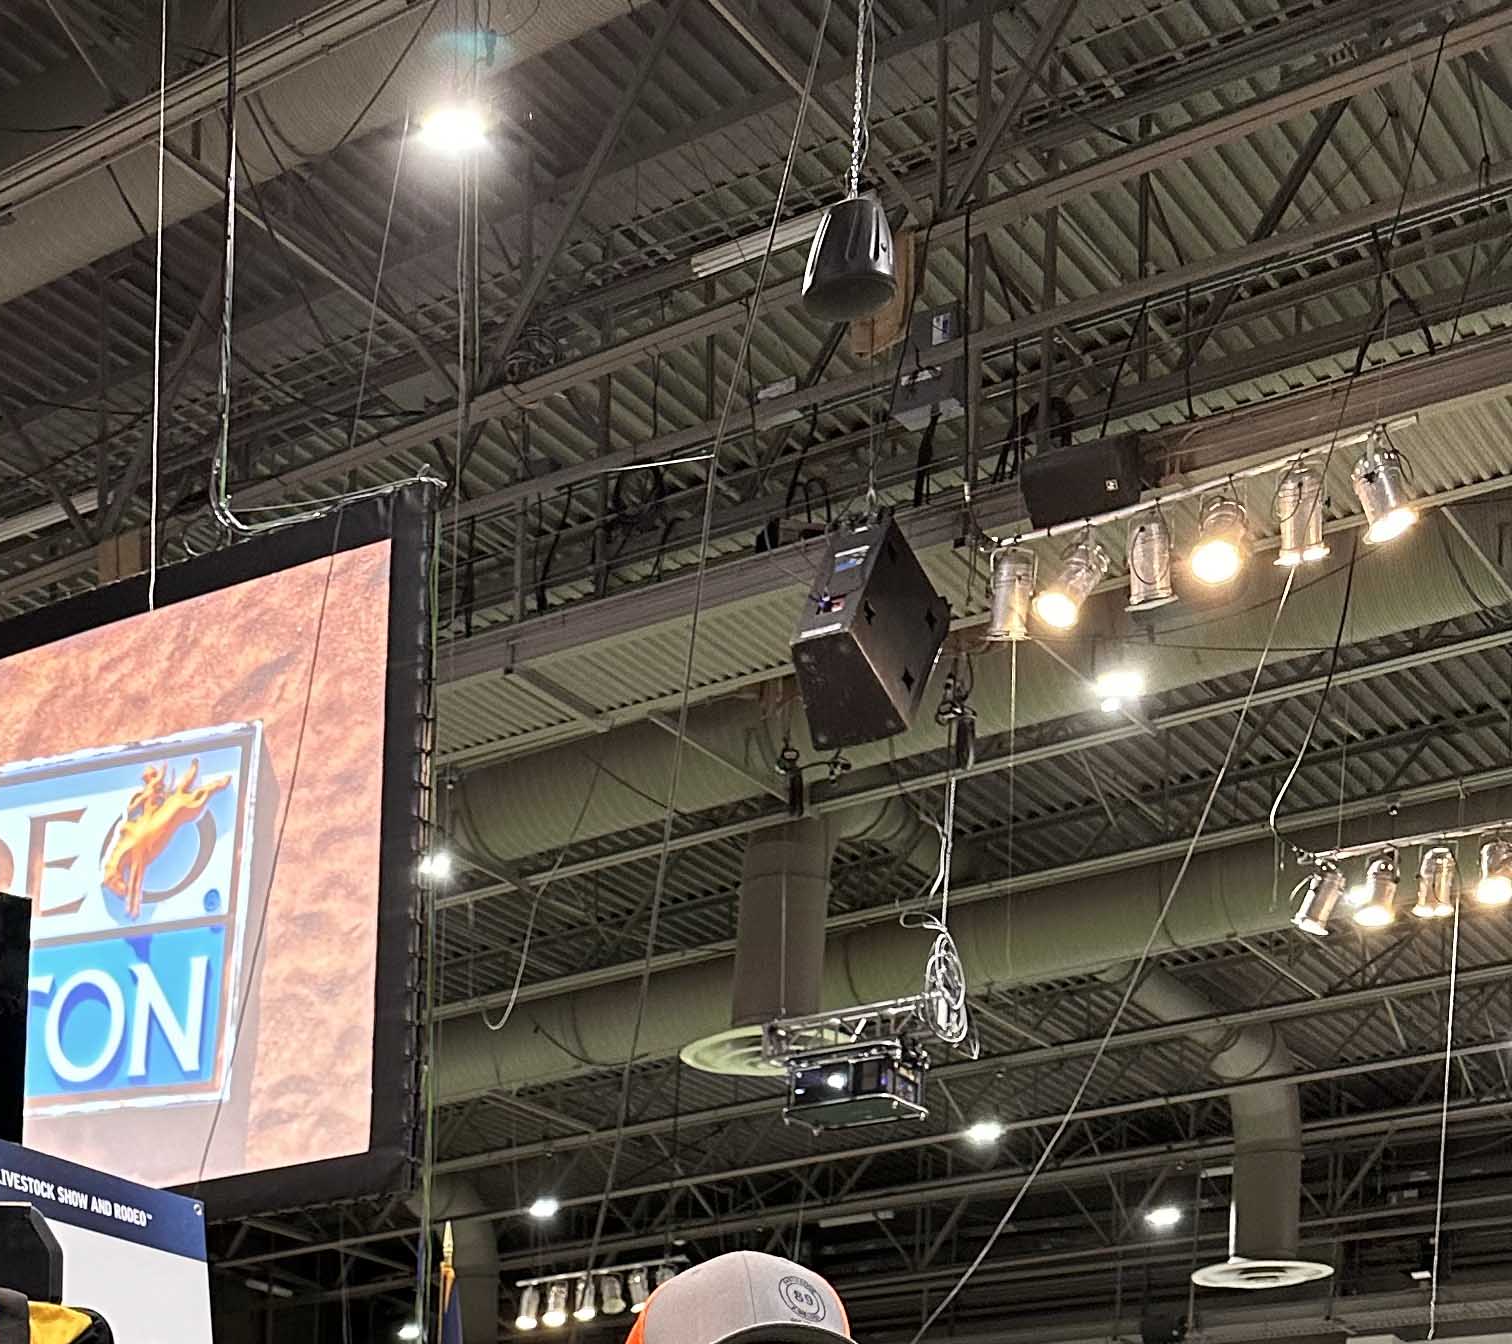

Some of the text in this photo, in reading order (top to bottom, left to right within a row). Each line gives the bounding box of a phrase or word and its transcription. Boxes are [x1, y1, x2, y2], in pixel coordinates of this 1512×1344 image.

[30, 956, 210, 1083] ON
[57, 1187, 87, 1210] SHOW
[90, 1196, 113, 1217] AND
